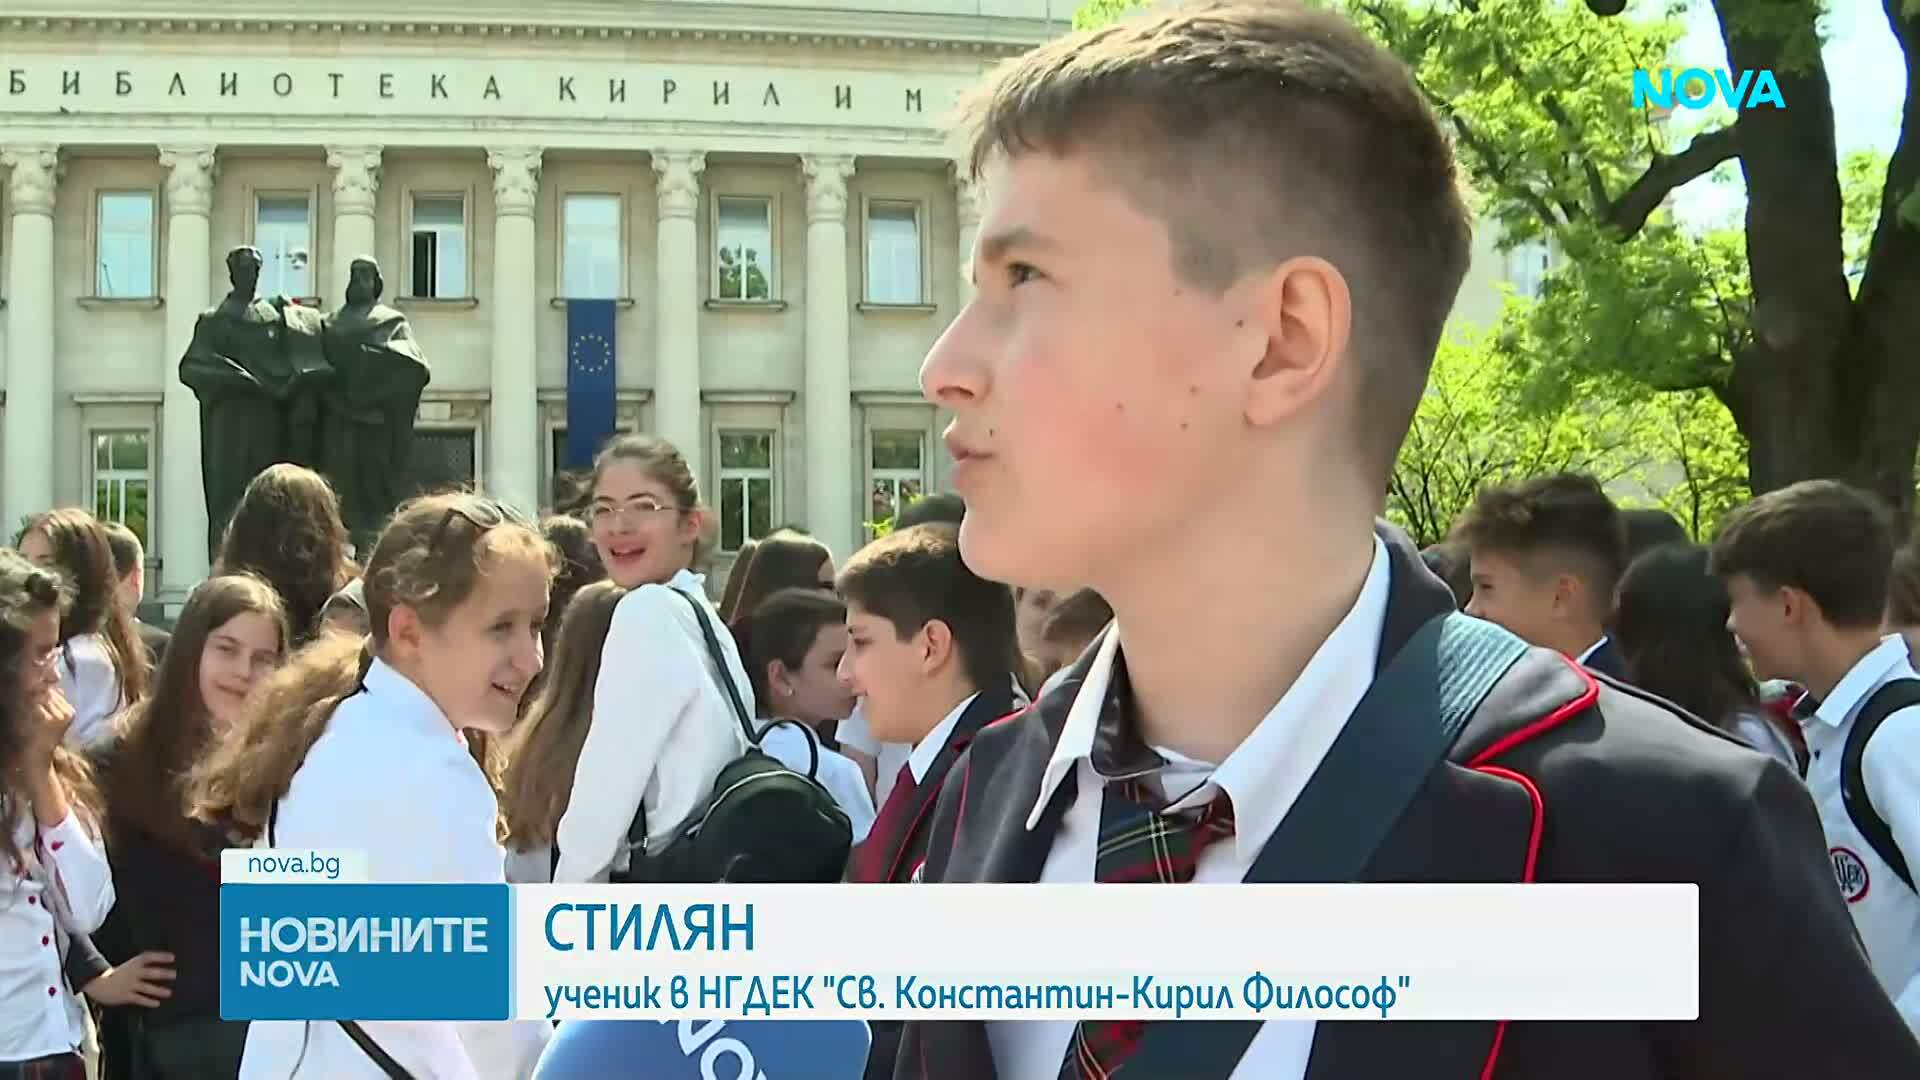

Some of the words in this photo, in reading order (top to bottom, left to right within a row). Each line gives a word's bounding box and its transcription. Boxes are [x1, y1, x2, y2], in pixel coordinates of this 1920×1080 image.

[8, 69, 503, 99] БИБЛИОТЕКА
[559, 76, 780, 106] КИРИЛ
[835, 85, 852, 110] И
